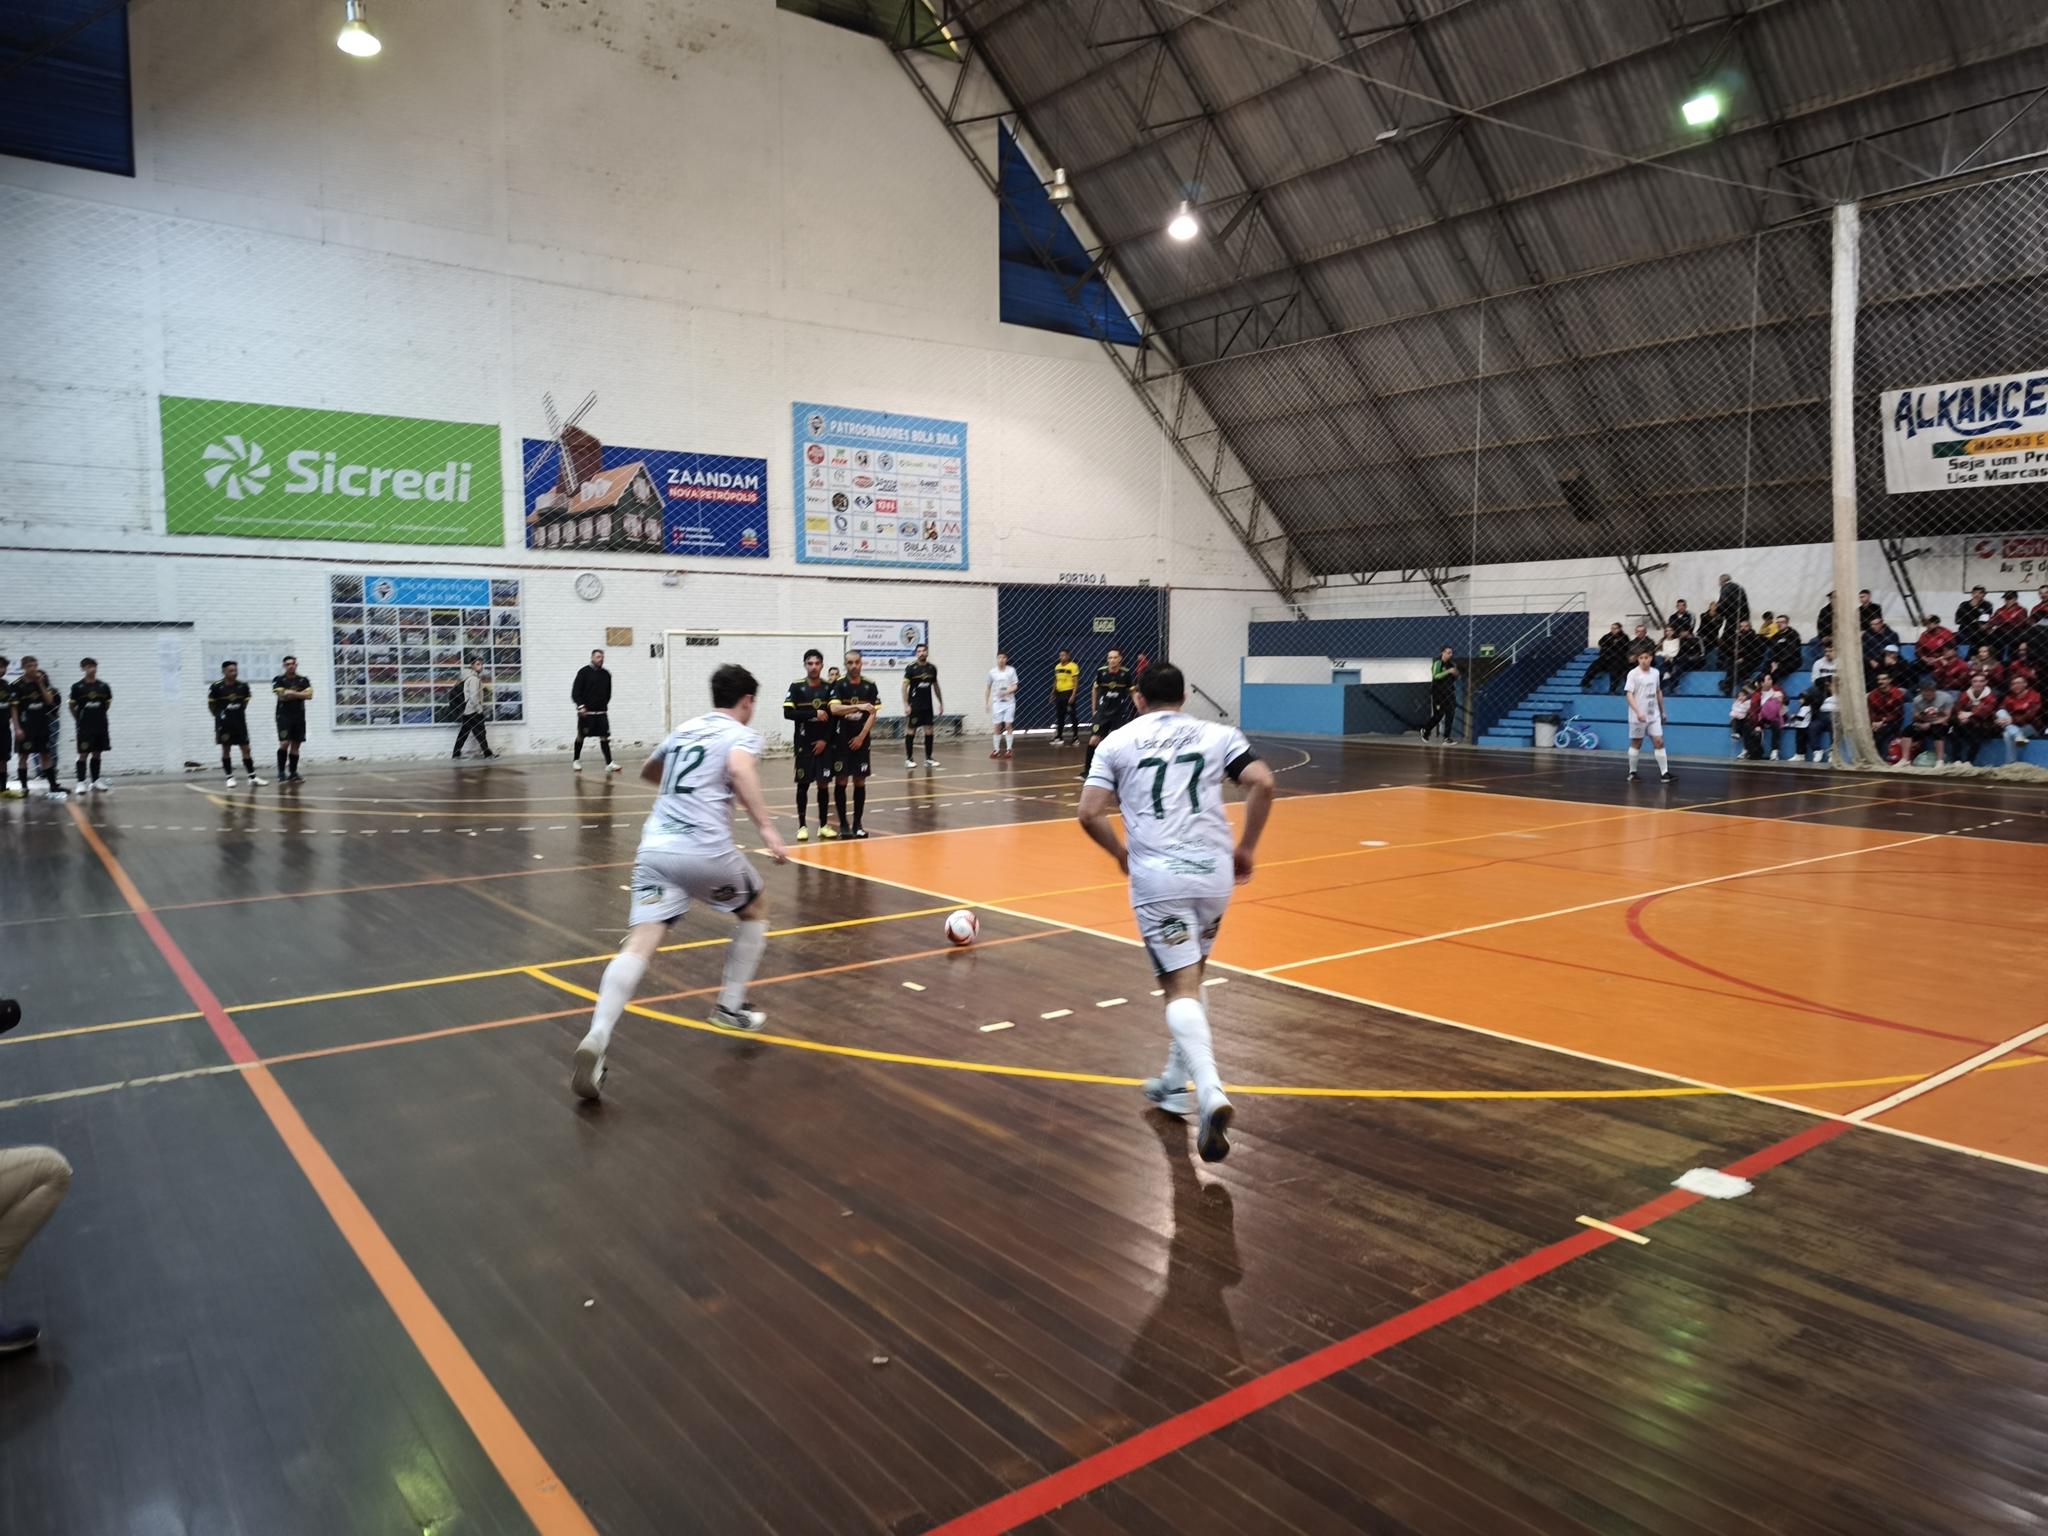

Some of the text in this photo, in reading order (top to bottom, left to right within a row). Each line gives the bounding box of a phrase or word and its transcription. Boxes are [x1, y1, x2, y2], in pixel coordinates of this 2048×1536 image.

[830, 421, 958, 446] PATROCINADORES BOLA BOLA
[1974, 434, 2045, 451] MARCAS E
[1948, 451, 2048, 472] Seja um Pr
[285, 449, 473, 503] Sicredi
[667, 468, 759, 491] ZAANDAM
[1947, 467, 2048, 484] Use Marcas
[668, 487, 698, 499] NOVA
[904, 541, 956, 554] BOLA BOLA
[2019, 560, 2033, 572] 15
[2038, 560, 2048, 572] d
[1099, 573, 1107, 585] A
[662, 744, 705, 795] 12
[1138, 751, 1206, 820] 77
